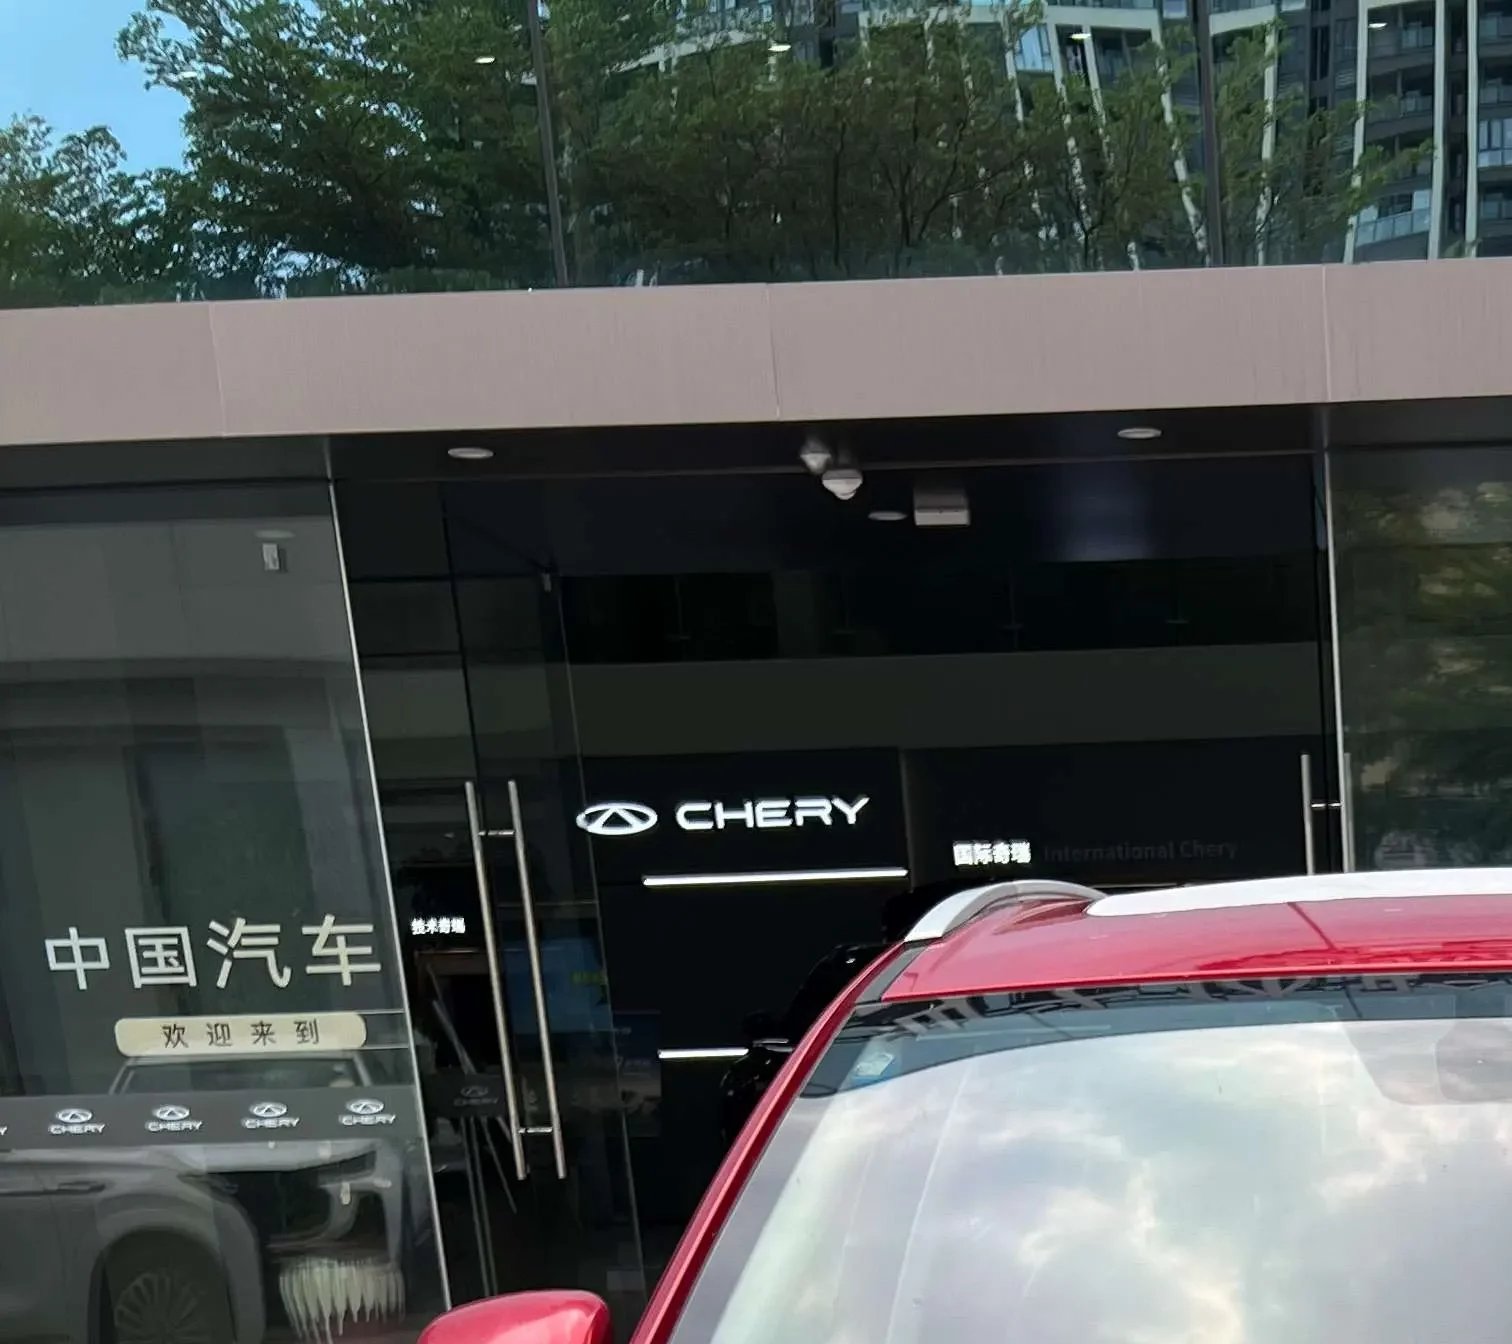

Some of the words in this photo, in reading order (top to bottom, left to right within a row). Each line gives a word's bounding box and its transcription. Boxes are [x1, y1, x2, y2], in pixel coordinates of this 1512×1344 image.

[675, 794, 870, 830] CHERY
[1044, 843, 1174, 862] International
[1180, 840, 1238, 861] Chery
[44, 913, 382, 990] 中国汽车
[161, 1018, 320, 1048] 欢迎来到
[49, 1123, 105, 1135] CHERY
[145, 1121, 202, 1133] CHERY
[242, 1117, 300, 1129] CHERY
[339, 1114, 397, 1126] CHERY
